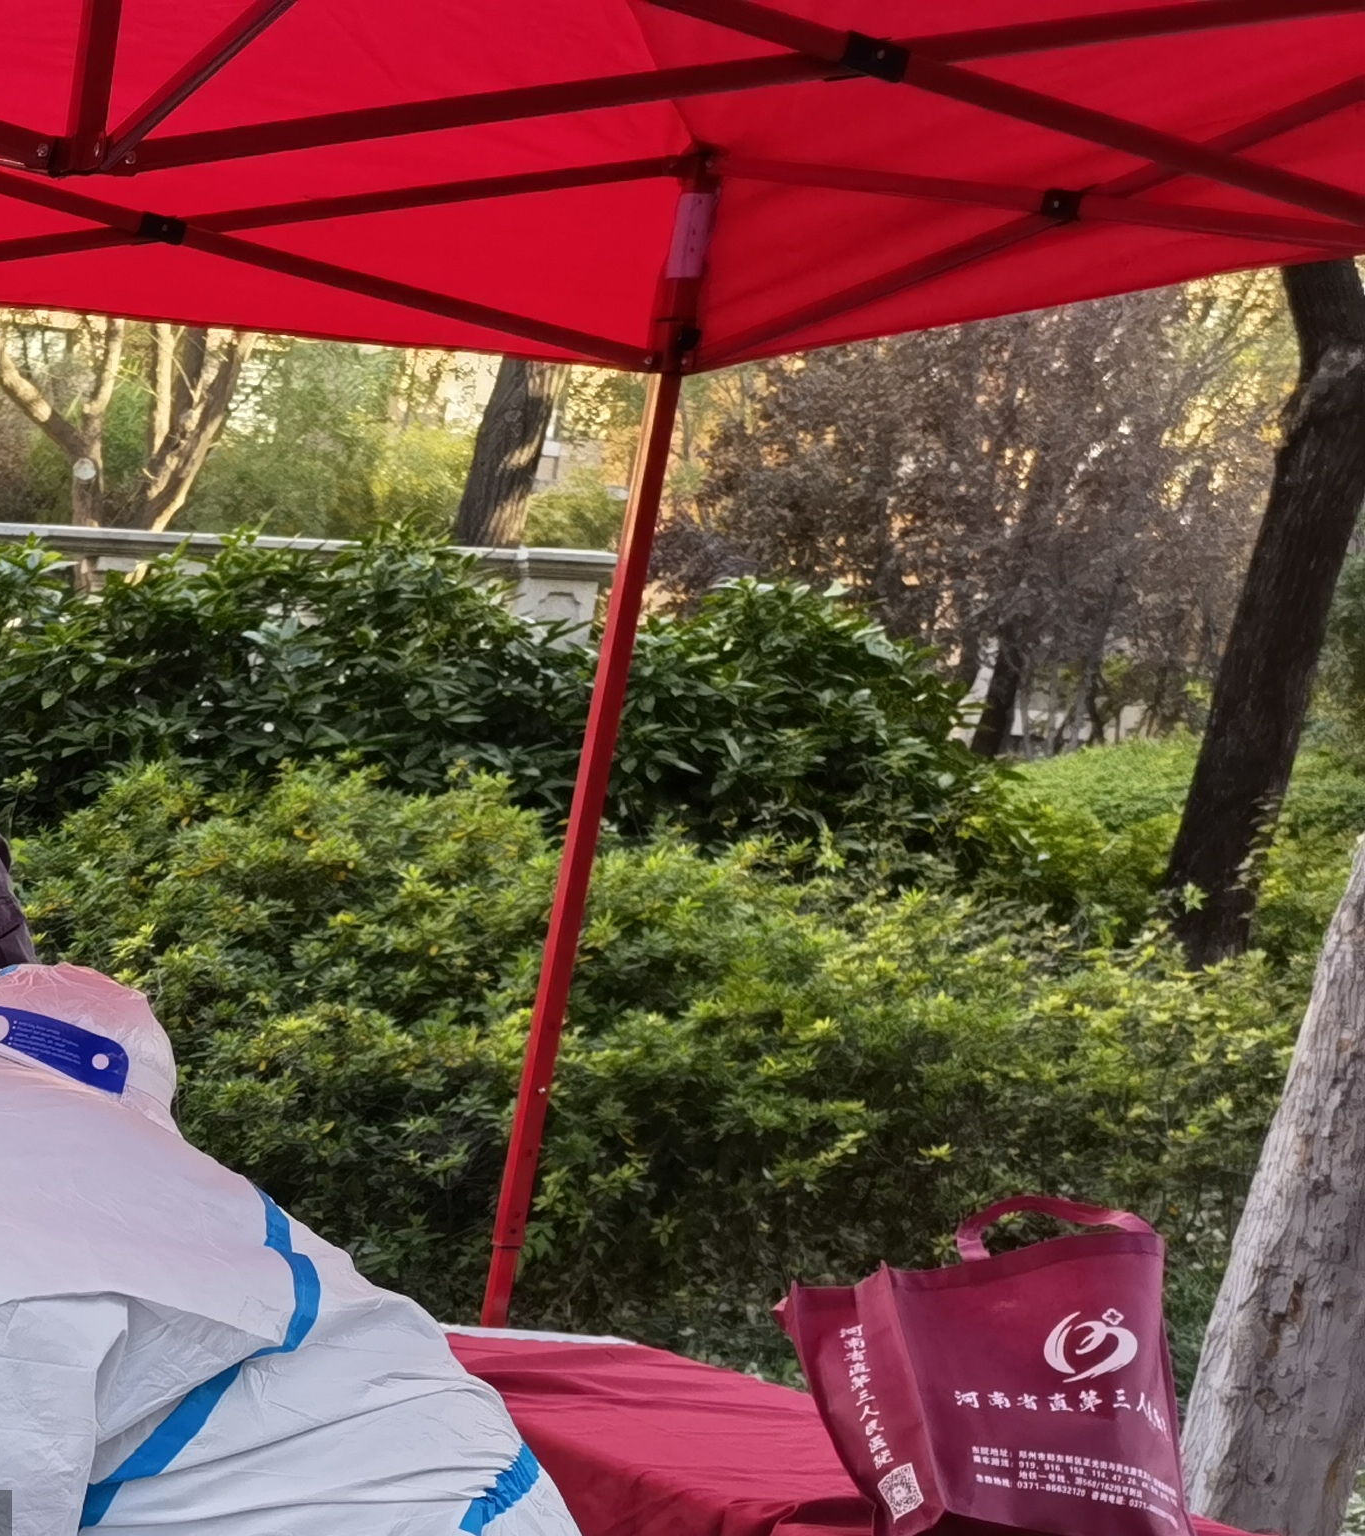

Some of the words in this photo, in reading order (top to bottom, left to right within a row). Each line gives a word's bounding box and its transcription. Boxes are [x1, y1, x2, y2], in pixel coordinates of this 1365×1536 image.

[839, 1323, 894, 1470] 河南省直第三人民医院
